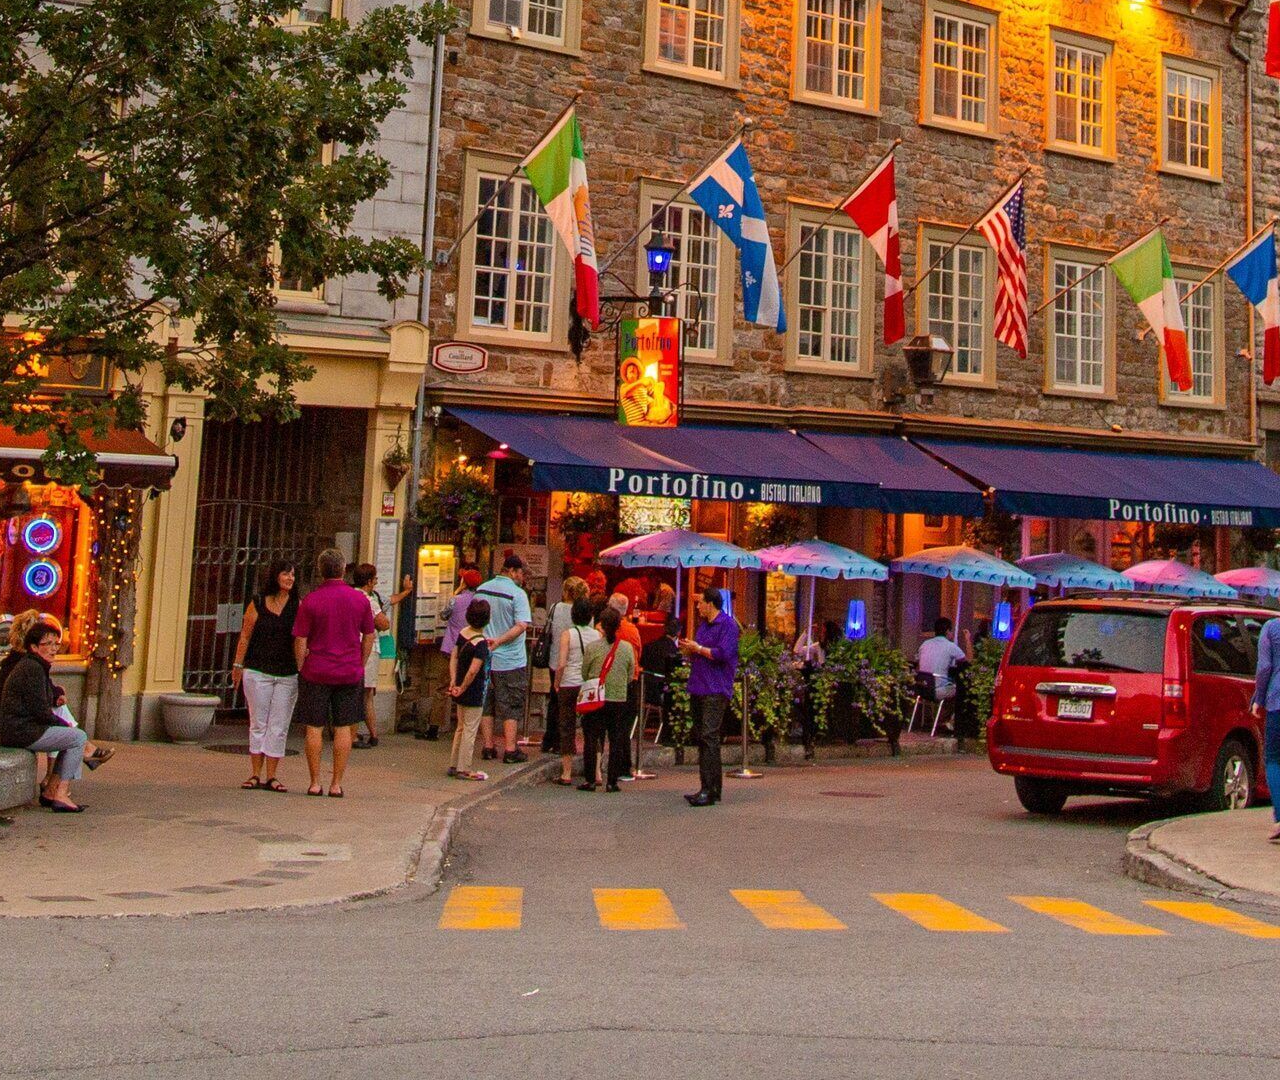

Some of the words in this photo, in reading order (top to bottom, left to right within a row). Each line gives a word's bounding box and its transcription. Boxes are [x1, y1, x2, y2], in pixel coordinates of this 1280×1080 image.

[607, 468, 744, 500] Portofino
[760, 483, 786, 502] BISTRO
[788, 485, 822, 503] ITALIANO
[1108, 498, 1200, 524] Portofino
